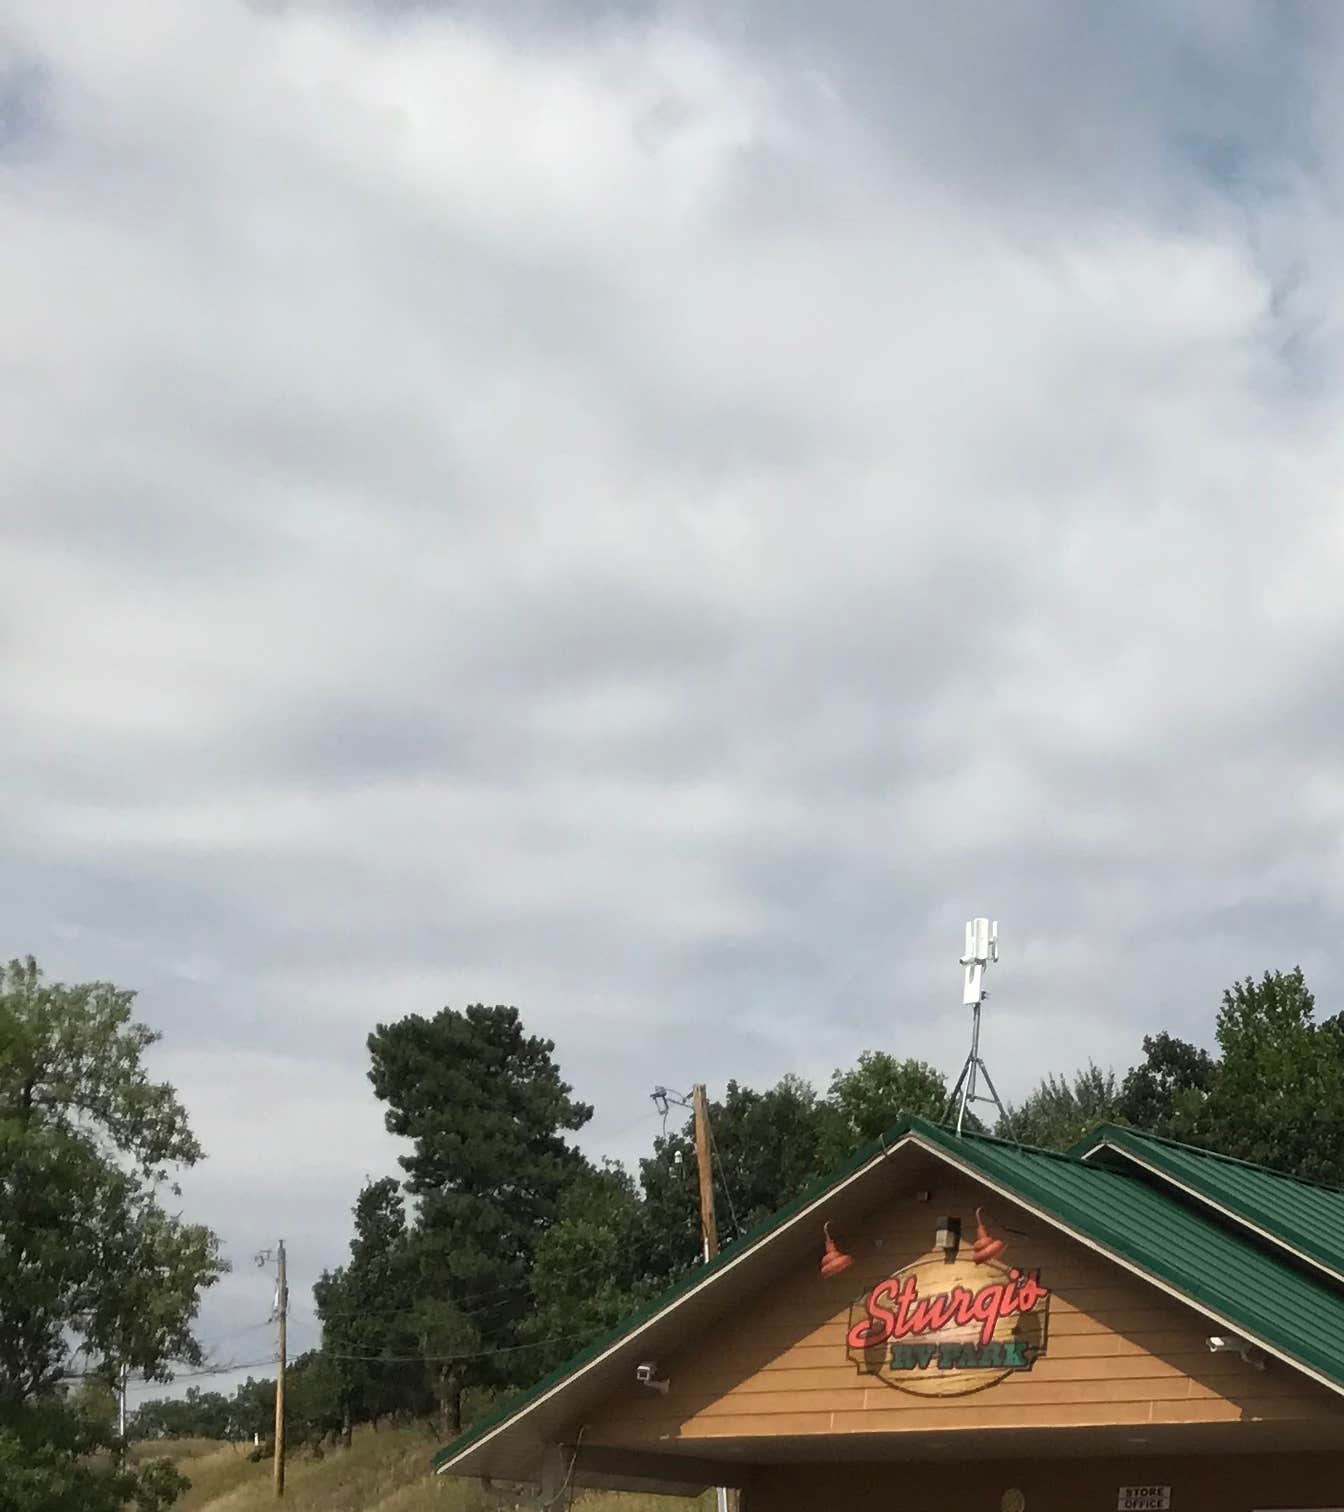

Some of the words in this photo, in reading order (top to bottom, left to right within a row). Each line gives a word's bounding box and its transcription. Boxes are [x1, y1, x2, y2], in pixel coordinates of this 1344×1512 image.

[847, 1268, 1048, 1350] Sturgis
[890, 1342, 937, 1370] RV
[939, 1341, 1027, 1370] PARK
[1126, 1487, 1164, 1497] STORE
[1125, 1499, 1164, 1509] OFFICE
